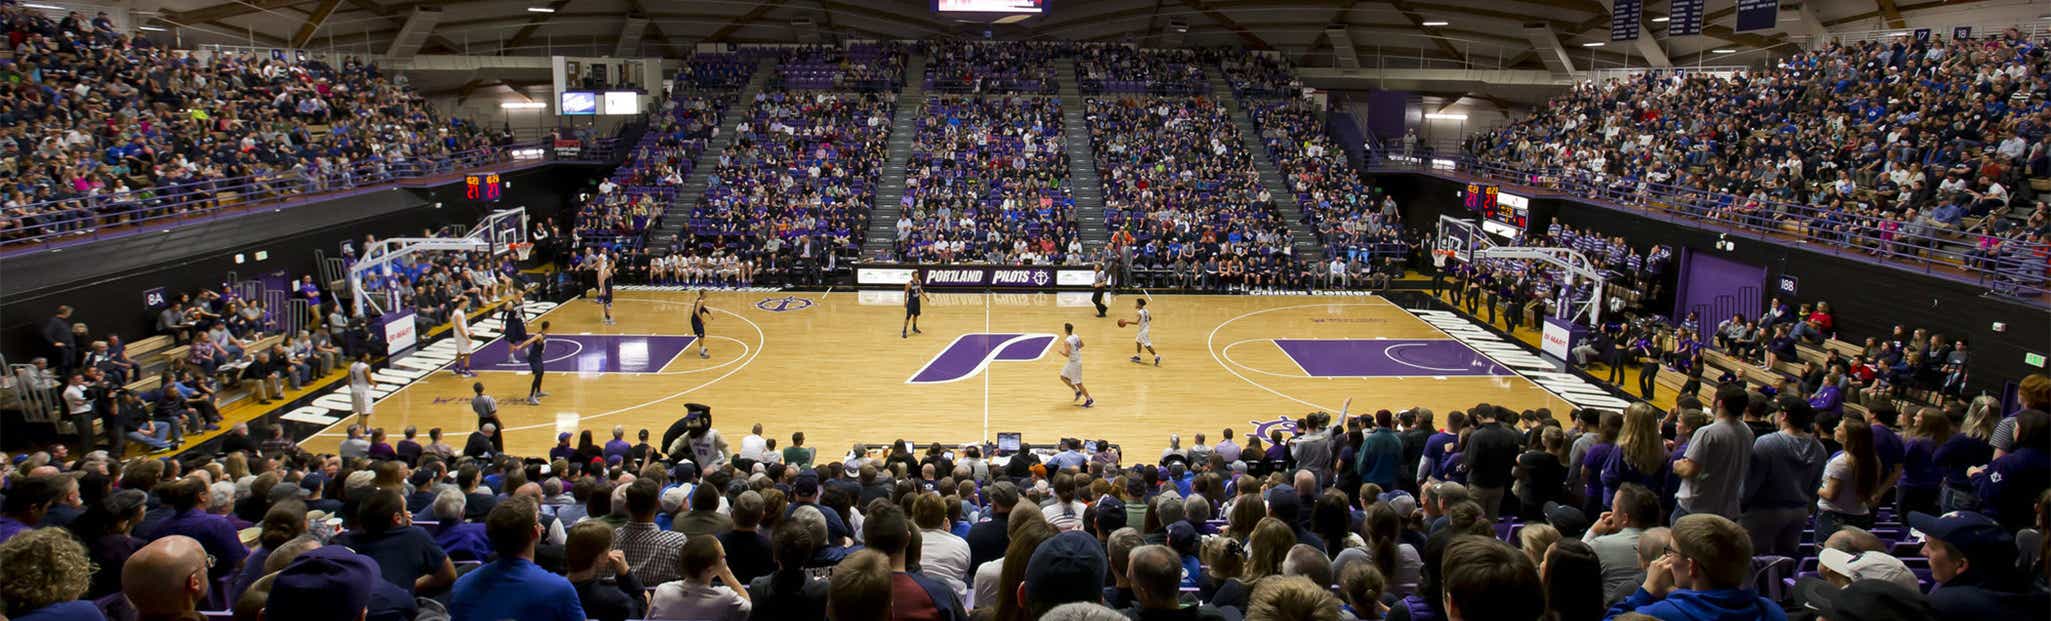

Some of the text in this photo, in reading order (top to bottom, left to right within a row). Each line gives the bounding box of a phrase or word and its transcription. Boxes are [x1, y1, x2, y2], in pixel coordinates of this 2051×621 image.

[925, 269, 1030, 284] PORTLAND PILOTS
[147, 293, 164, 306] 8A
